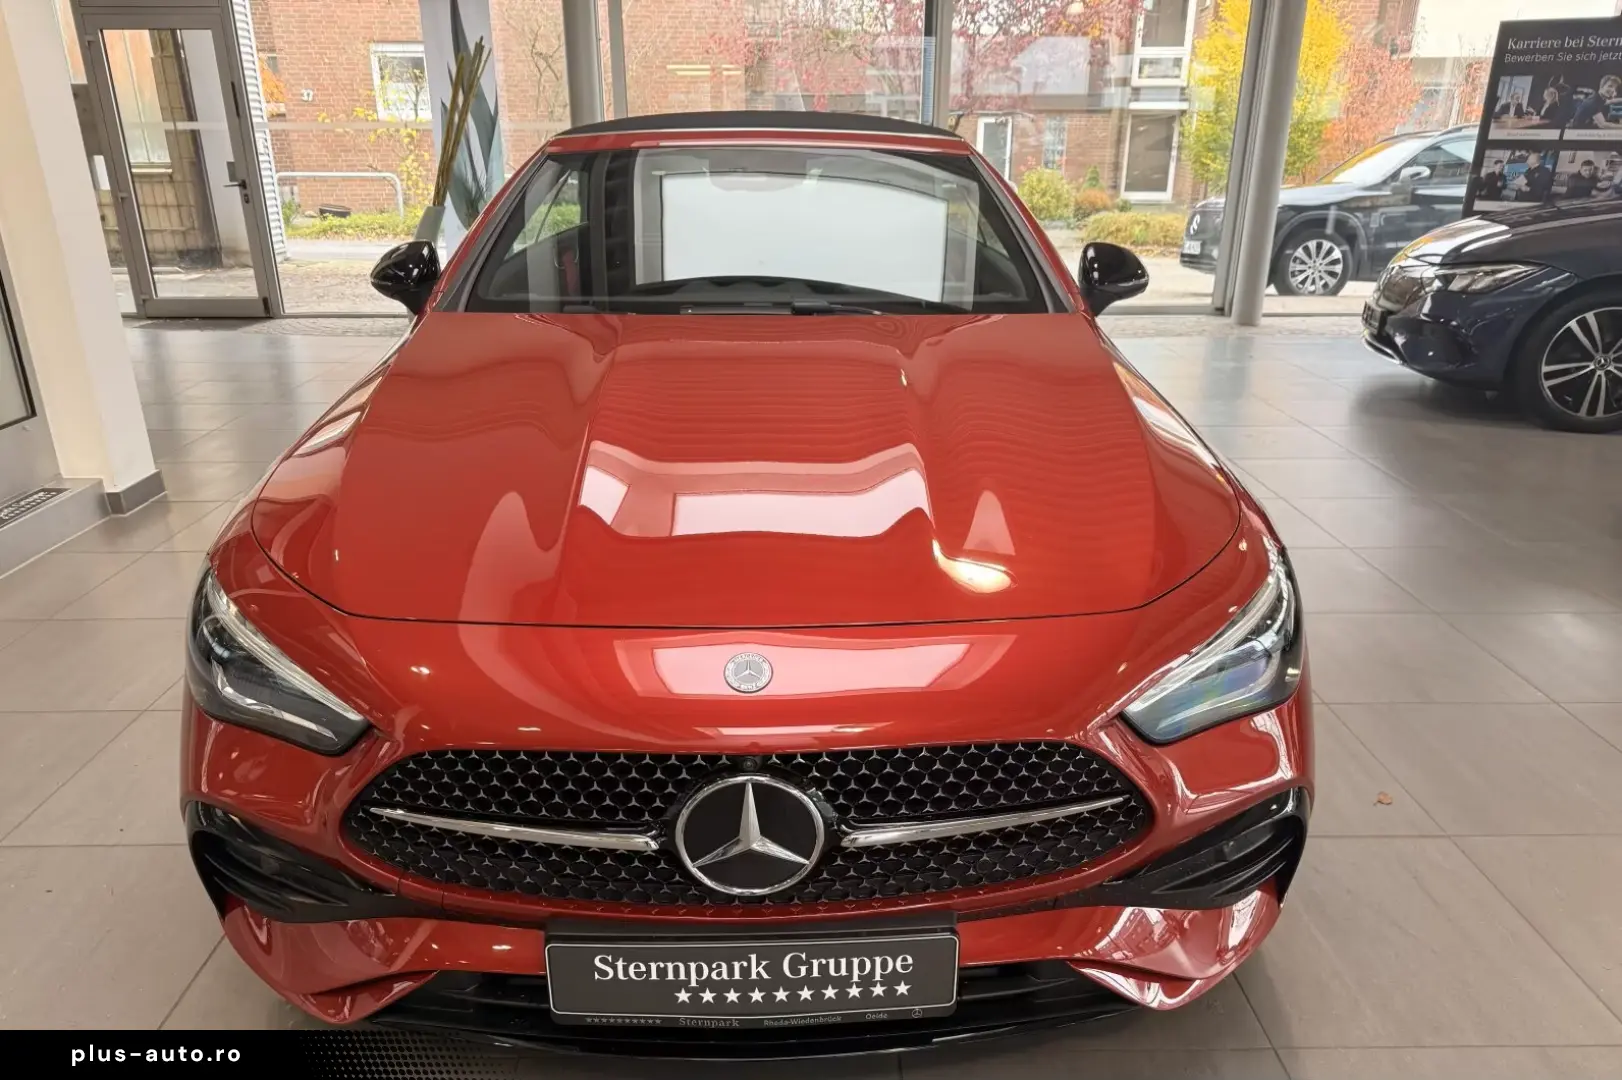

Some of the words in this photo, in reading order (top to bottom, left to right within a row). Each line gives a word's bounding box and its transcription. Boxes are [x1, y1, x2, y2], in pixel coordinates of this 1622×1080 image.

[1507, 37, 1561, 50] Karriere
[1564, 35, 1584, 48] bei
[1504, 52, 1554, 63] Bewerben
[1556, 52, 1573, 62] Sie
[1575, 51, 1596, 61] sich
[1598, 50, 1622, 62] jetzt
[594, 953, 772, 987] Sternpark
[782, 951, 914, 983] Gruppe
[679, 1017, 740, 1029] Sternpark
